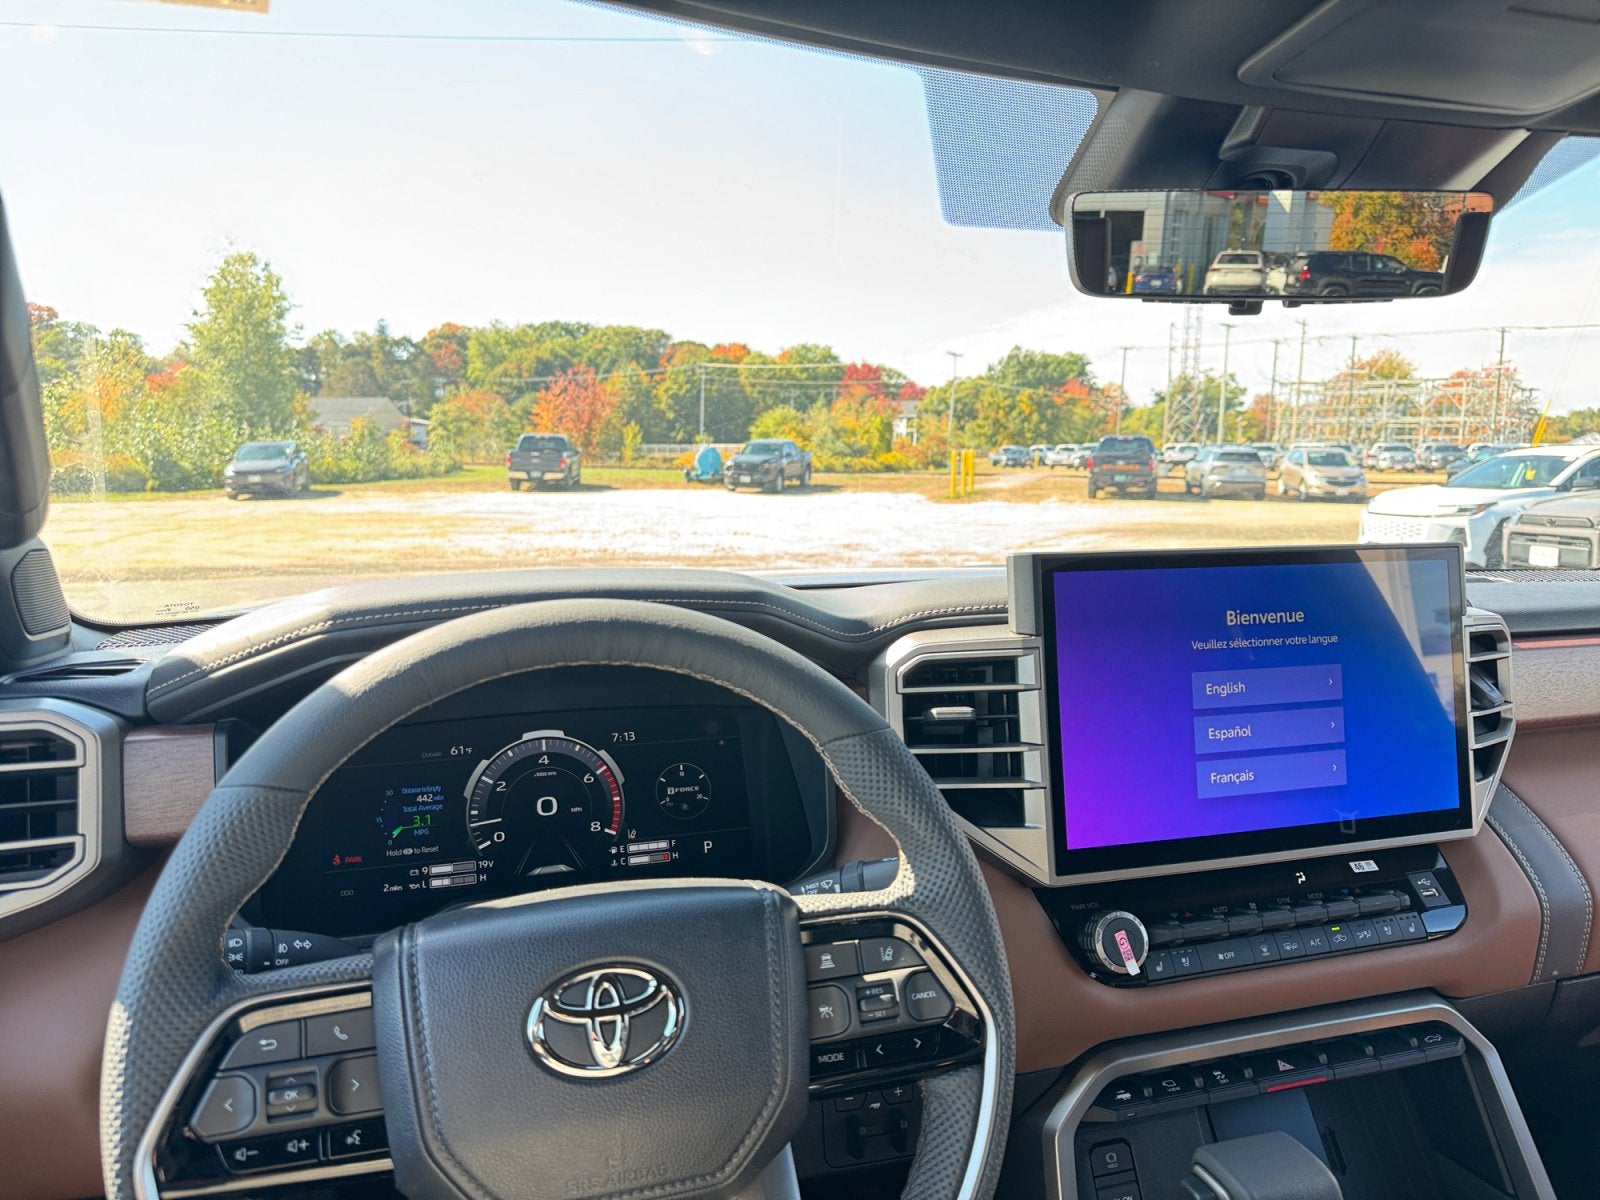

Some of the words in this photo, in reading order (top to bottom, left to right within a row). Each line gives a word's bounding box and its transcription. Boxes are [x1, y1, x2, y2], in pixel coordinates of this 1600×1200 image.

[1226, 610, 1305, 626] Bienvenue
[1191, 639, 1228, 650] Veuillez
[1229, 636, 1283, 648] sélectionner
[1285, 635, 1307, 645] votre
[1308, 633, 1338, 645] langue
[1206, 681, 1246, 697] English
[611, 731, 636, 742] 7:13
[1208, 725, 1252, 742] Español
[538, 755, 550, 765] 4
[583, 773, 594, 784] 6
[1210, 769, 1255, 785] Français
[496, 781, 507, 792] 2
[416, 793, 433, 802] 442
[418, 803, 444, 811] Average
[536, 796, 558, 816] 0
[412, 814, 432, 827] 3.1
[413, 828, 430, 836] MPG
[590, 822, 602, 832] 8
[494, 832, 506, 842] 0
[386, 849, 402, 857] Hold
[619, 845, 625, 853] E
[703, 841, 713, 854] P
[620, 858, 626, 866] C
[422, 867, 429, 875] 9
[478, 861, 494, 869] 19V
[422, 880, 427, 888] L
[479, 874, 487, 882] H
[1310, 938, 1322, 947] A/C
[1223, 951, 1235, 960] OFF
[911, 990, 937, 1000] CANCEL
[817, 1052, 845, 1064] MODE
[284, 1090, 299, 1100] OK
